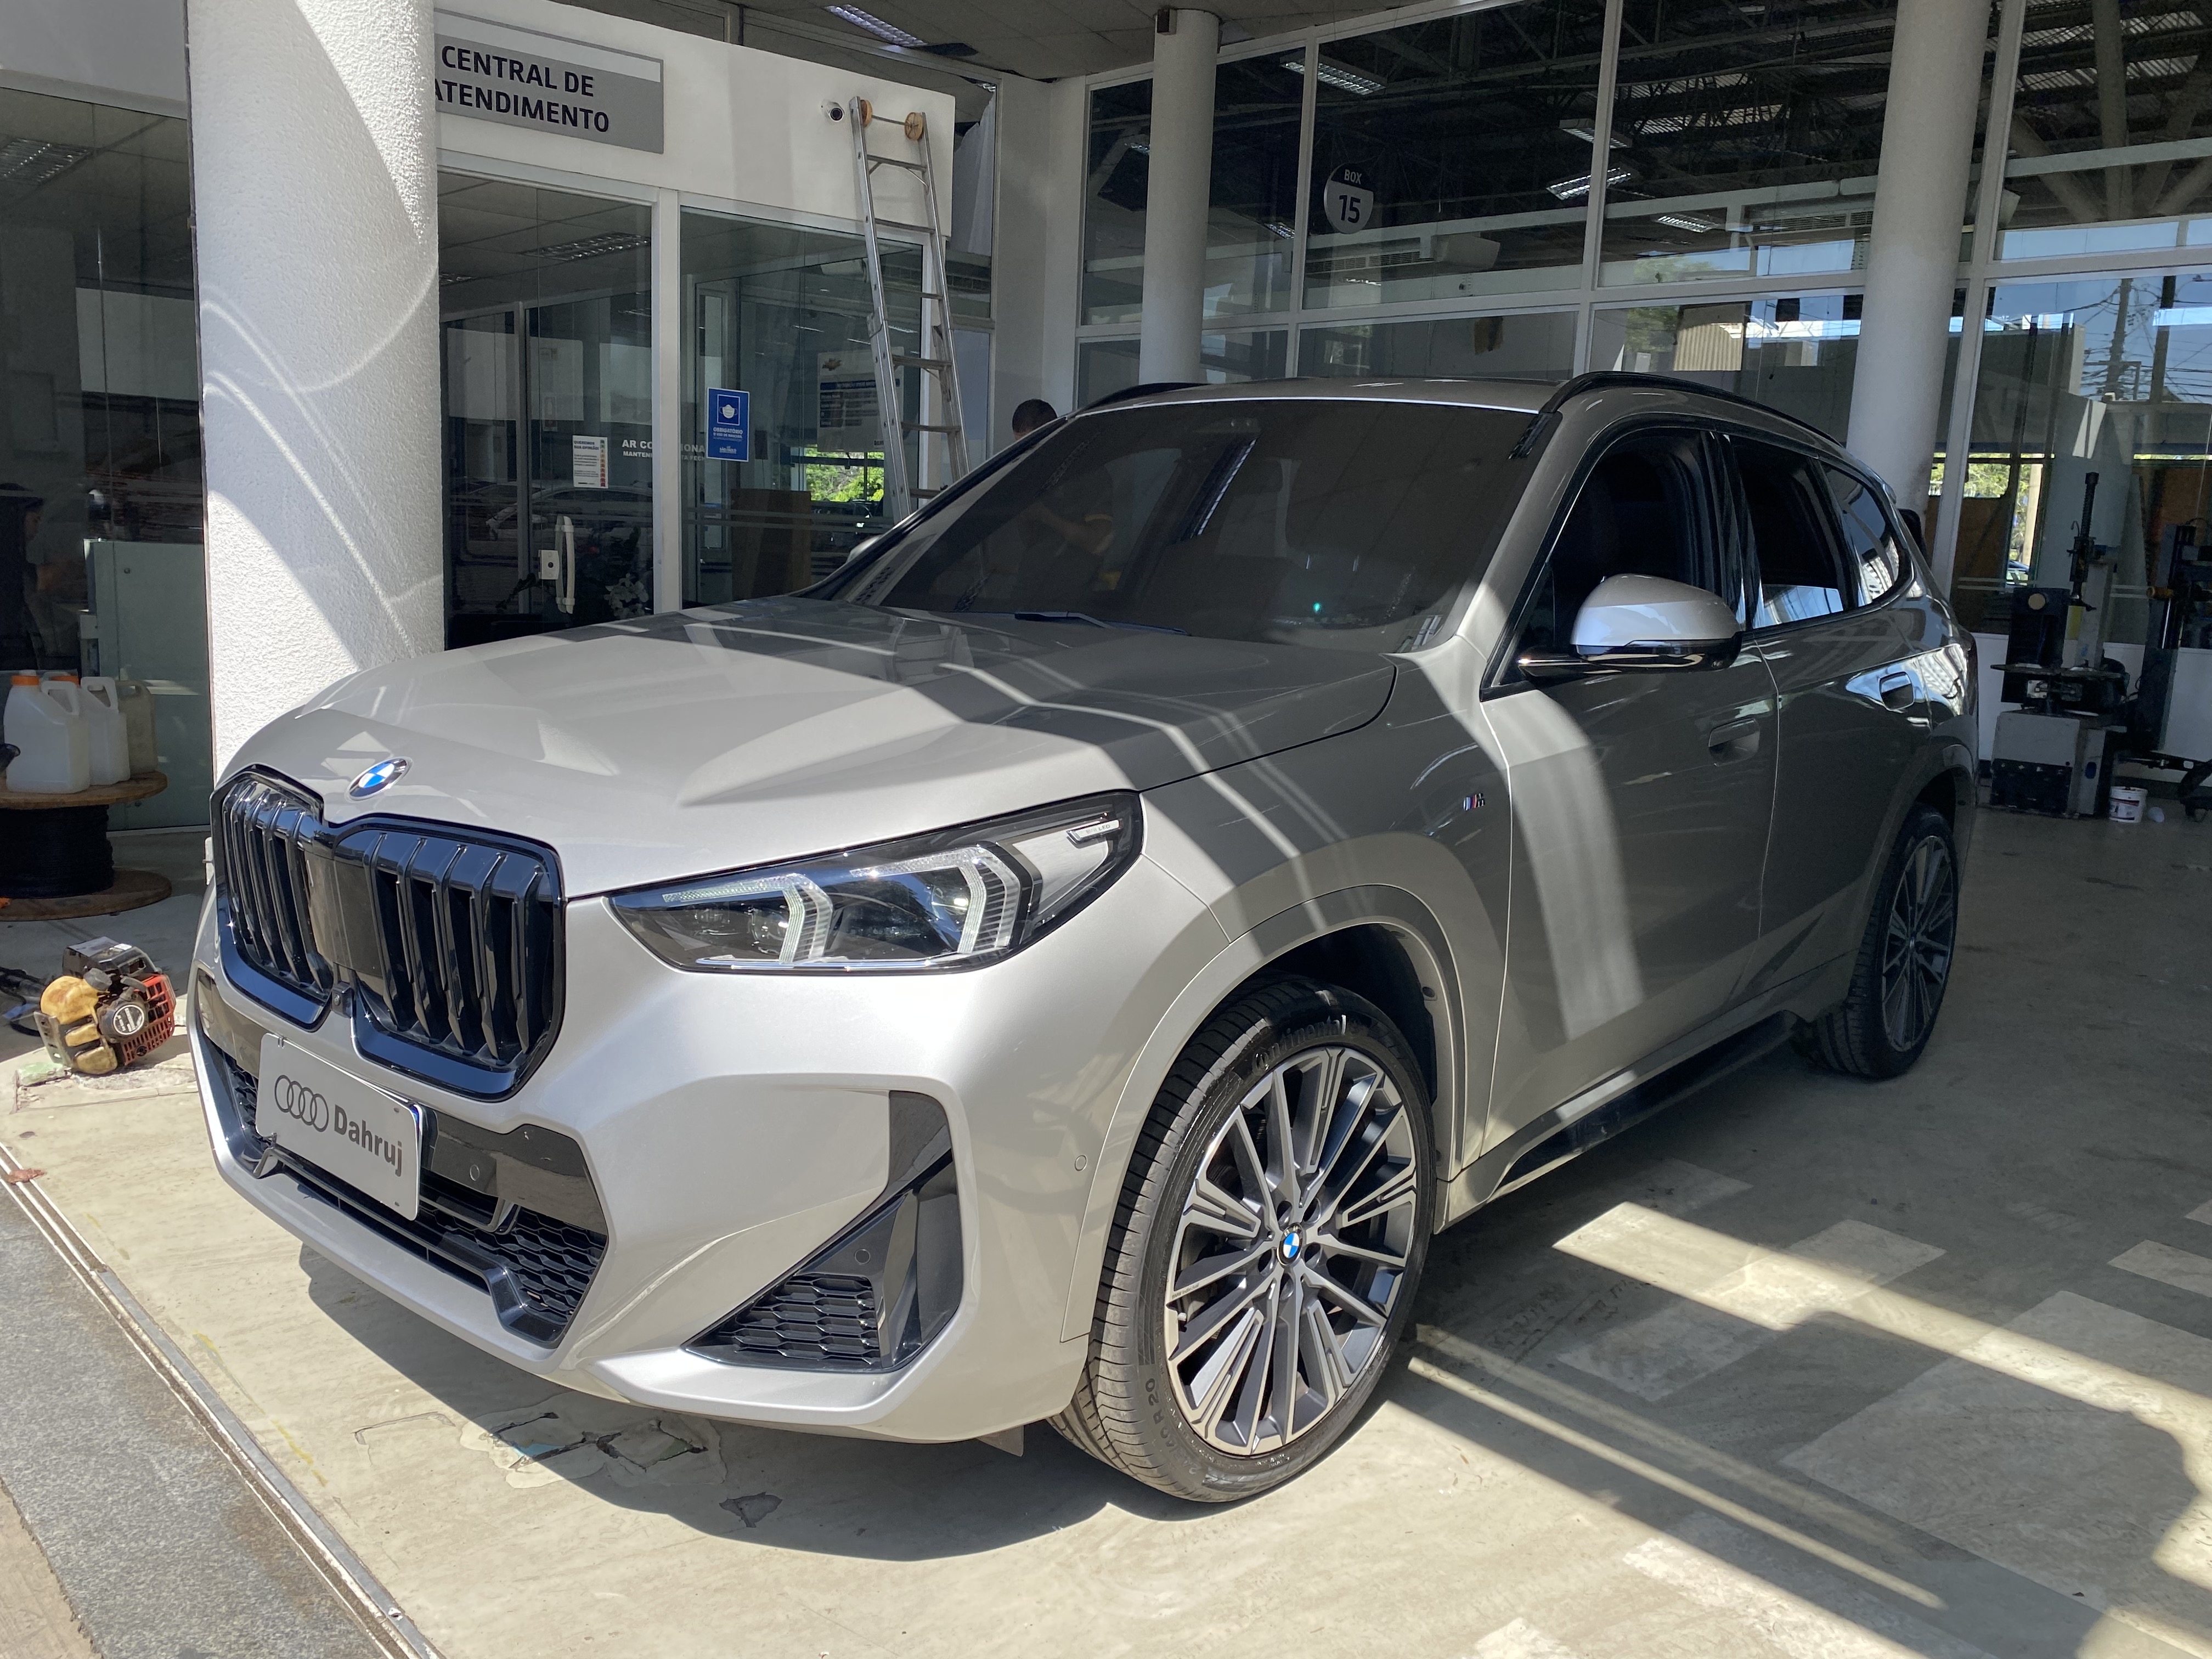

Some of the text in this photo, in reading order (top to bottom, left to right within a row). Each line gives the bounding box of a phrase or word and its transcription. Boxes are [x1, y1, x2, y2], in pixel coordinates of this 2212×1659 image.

[442, 46, 594, 97] CENTRAL DE
[1344, 169, 1362, 185] BOX
[1339, 195, 1361, 223] 15
[622, 439, 636, 448] AR
[334, 1104, 402, 1177] Dahruj
[1146, 1378, 1159, 1407] 20
[1153, 1409, 1165, 1425] R
